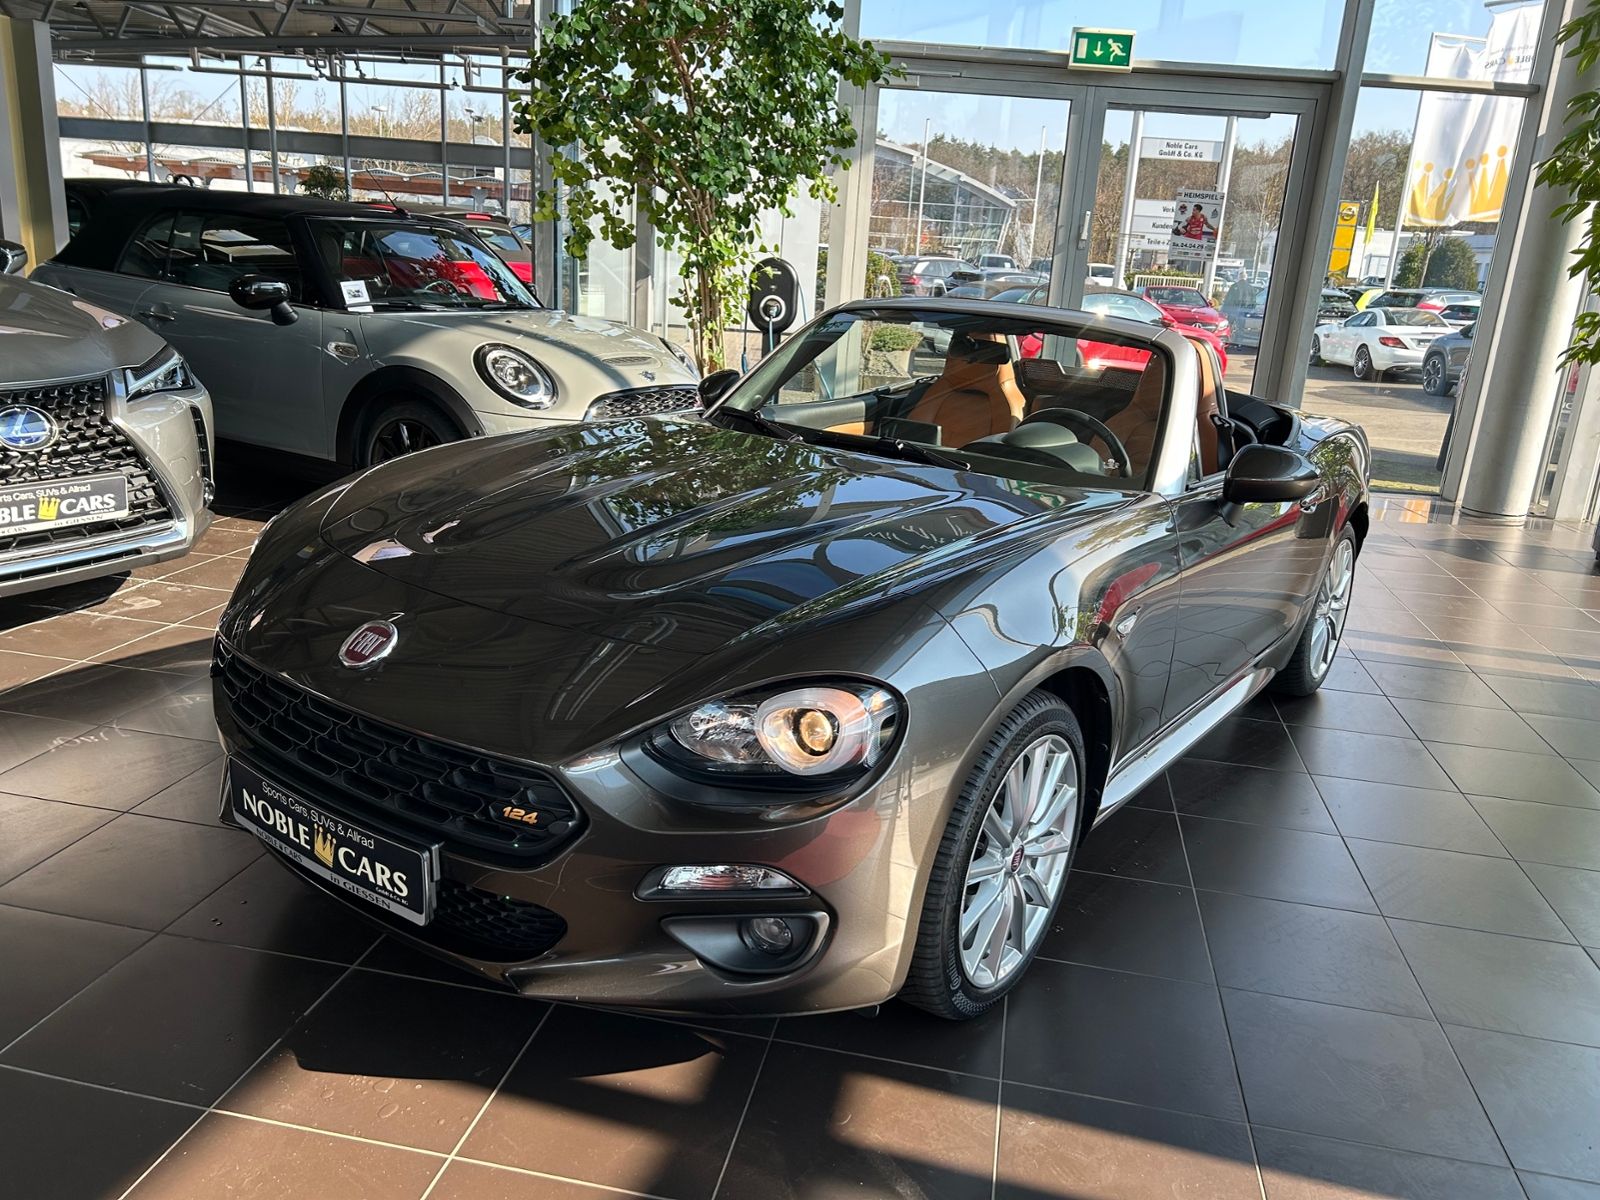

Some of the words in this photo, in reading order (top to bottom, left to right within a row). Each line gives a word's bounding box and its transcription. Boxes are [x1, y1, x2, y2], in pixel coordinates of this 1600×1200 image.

[1183, 192, 1219, 201] HEIMSPIEL
[12, 492, 36, 501] Cars,
[36, 488, 59, 497] SUVs
[60, 487, 67, 495] &
[68, 484, 91, 493] Allrad
[60, 493, 116, 515] CARS
[349, 631, 387, 656] FIAT
[262, 781, 288, 805] Sports
[288, 797, 309, 820] Cars,
[310, 809, 336, 832] SUVs
[337, 823, 345, 837] &
[346, 828, 375, 850] Allrad
[502, 806, 538, 825] 124
[242, 787, 311, 850] NOBLE
[338, 846, 409, 897] CARS
[256, 827, 279, 848] NOBLE
[284, 846, 303, 863] CARS
[330, 873, 340, 885] in
[343, 881, 391, 910] GIESSEN
